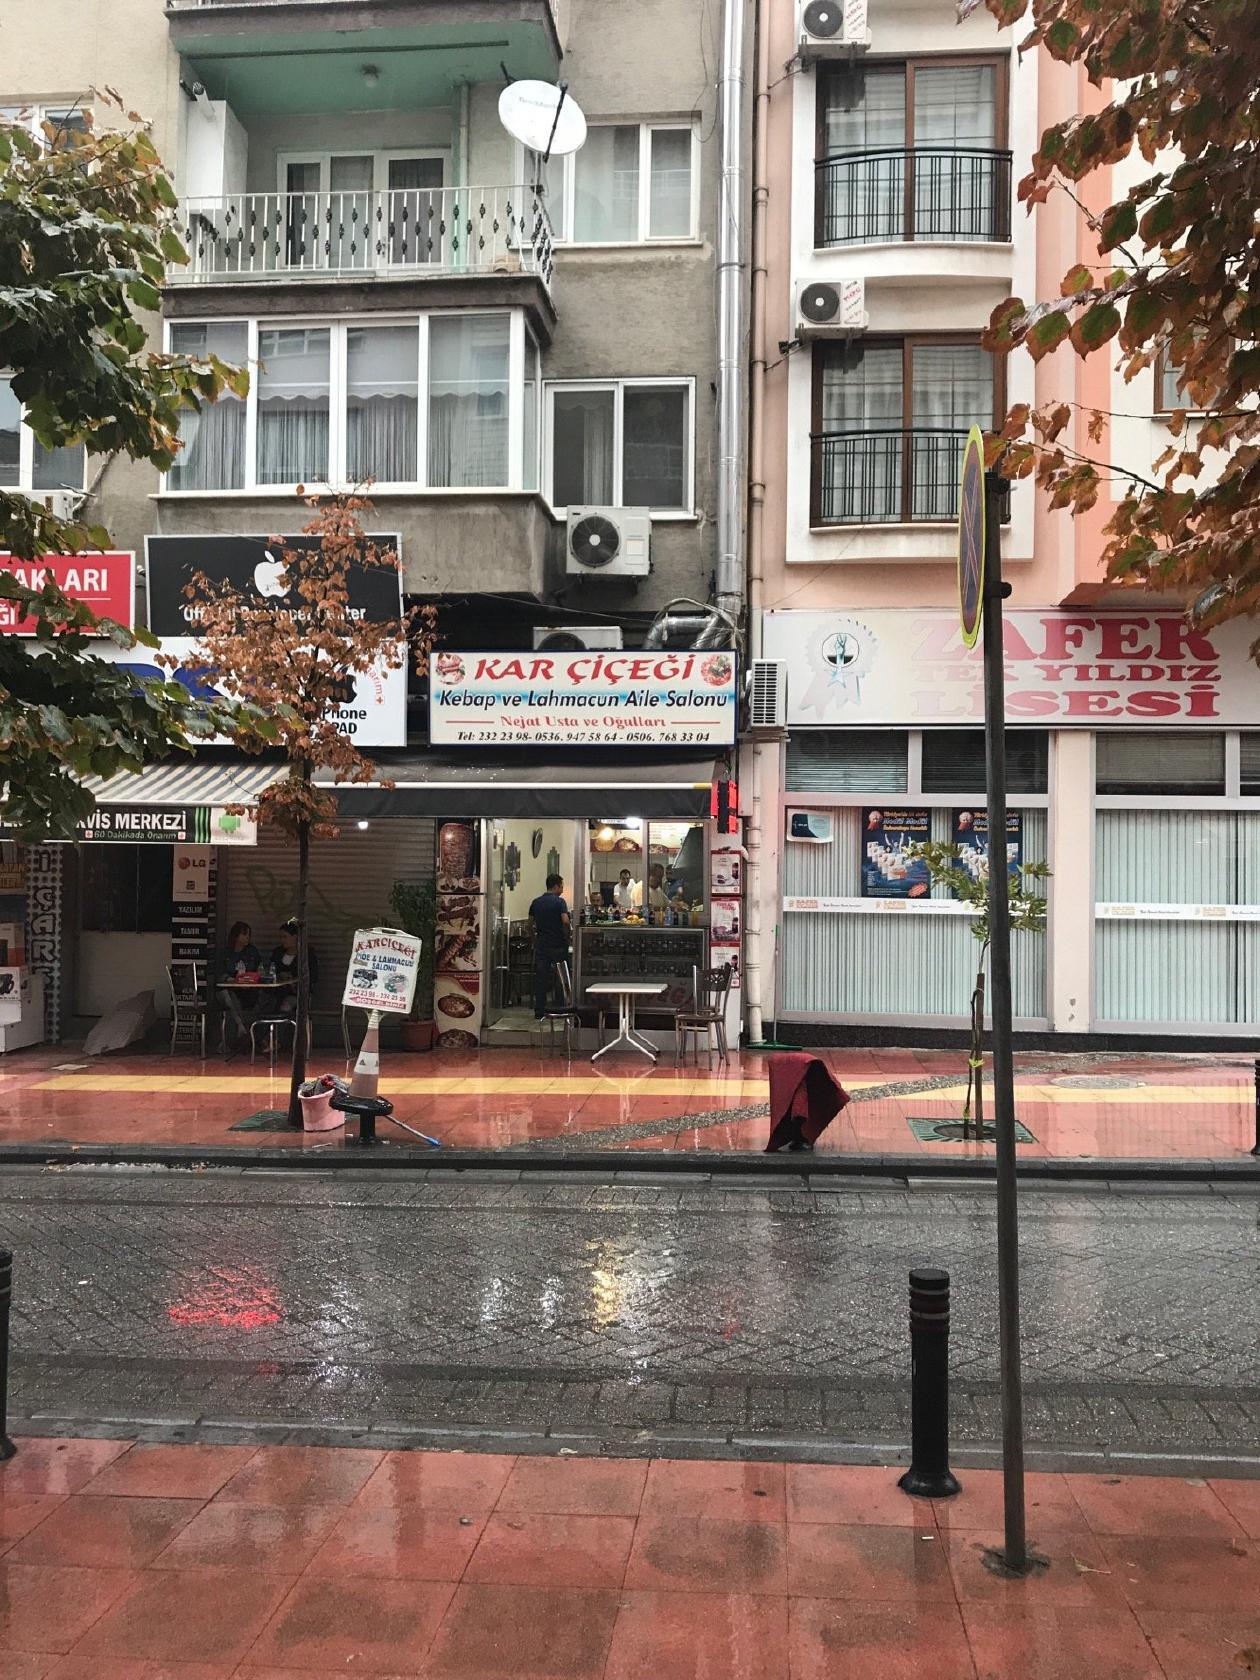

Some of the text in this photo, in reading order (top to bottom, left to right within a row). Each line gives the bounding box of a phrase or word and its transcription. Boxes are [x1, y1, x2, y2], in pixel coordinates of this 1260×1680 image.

[911, 617, 1221, 661] ZAFER
[475, 654, 696, 685] KAR ÇİÇEĞİ
[914, 664, 1222, 682] TEK YILDIZ
[440, 689, 727, 710] Kebap ve Lahmacun Aile Salonu
[911, 684, 1221, 717] LİSESİ
[501, 715, 666, 730] Nejat Usta ve Oğulları
[458, 731, 475, 741] Tel:
[480, 732, 497, 741] 232
[500, 732, 513, 741] 23
[567, 732, 585, 741] 947
[588, 732, 601, 741] 58
[604, 732, 618, 741] 64
[659, 732, 677, 741] 768
[680, 732, 694, 741] 33
[696, 732, 710, 741] 04
[115, 810, 187, 830] MERKEZİ
[94, 831, 105, 840] 60
[107, 831, 145, 840] Dakikada
[192, 859, 206, 868] LG
